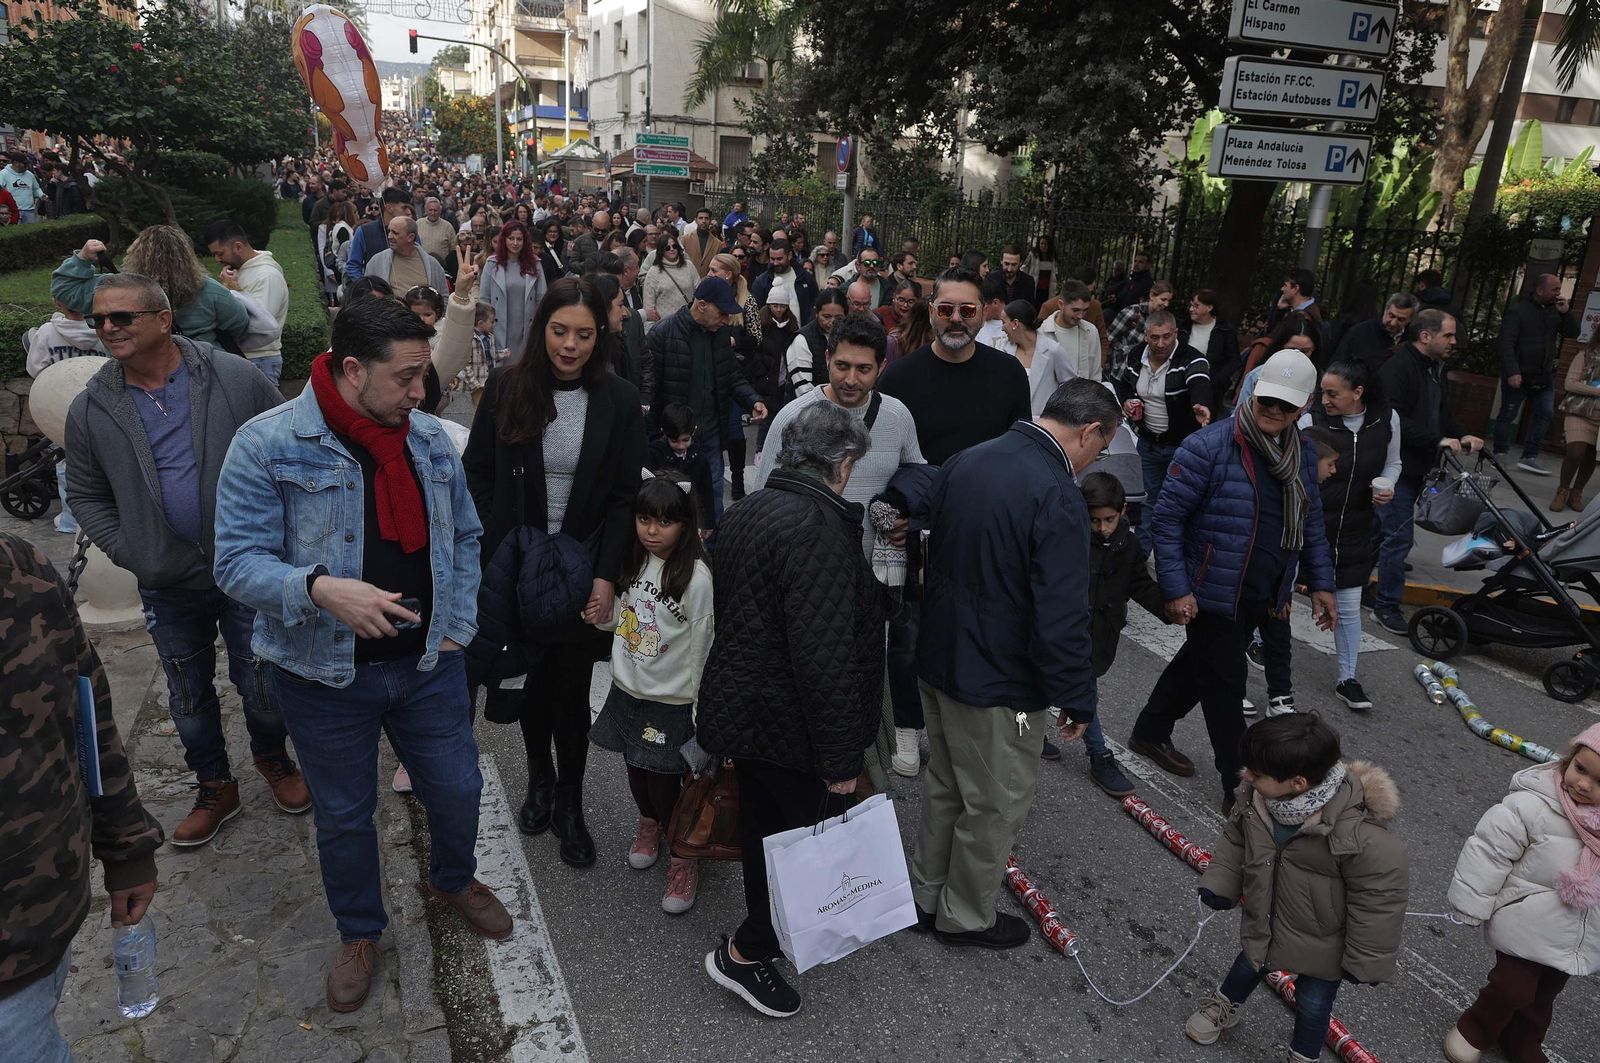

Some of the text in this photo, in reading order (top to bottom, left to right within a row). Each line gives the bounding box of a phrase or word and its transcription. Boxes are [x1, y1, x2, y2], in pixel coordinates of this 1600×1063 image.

[1262, 0, 1300, 15] Carmen
[1245, 15, 1286, 32] Hispano
[1238, 70, 1315, 88] Estación FF.CC.
[1236, 88, 1331, 106] Estación Autobuses
[1227, 136, 1303, 153] Plaza Andalucía
[1224, 154, 1307, 170] Menéndez Tolosa
[643, 580, 688, 624] Together
[850, 879, 882, 896] MEDINA
[817, 894, 847, 915] AROMAS
